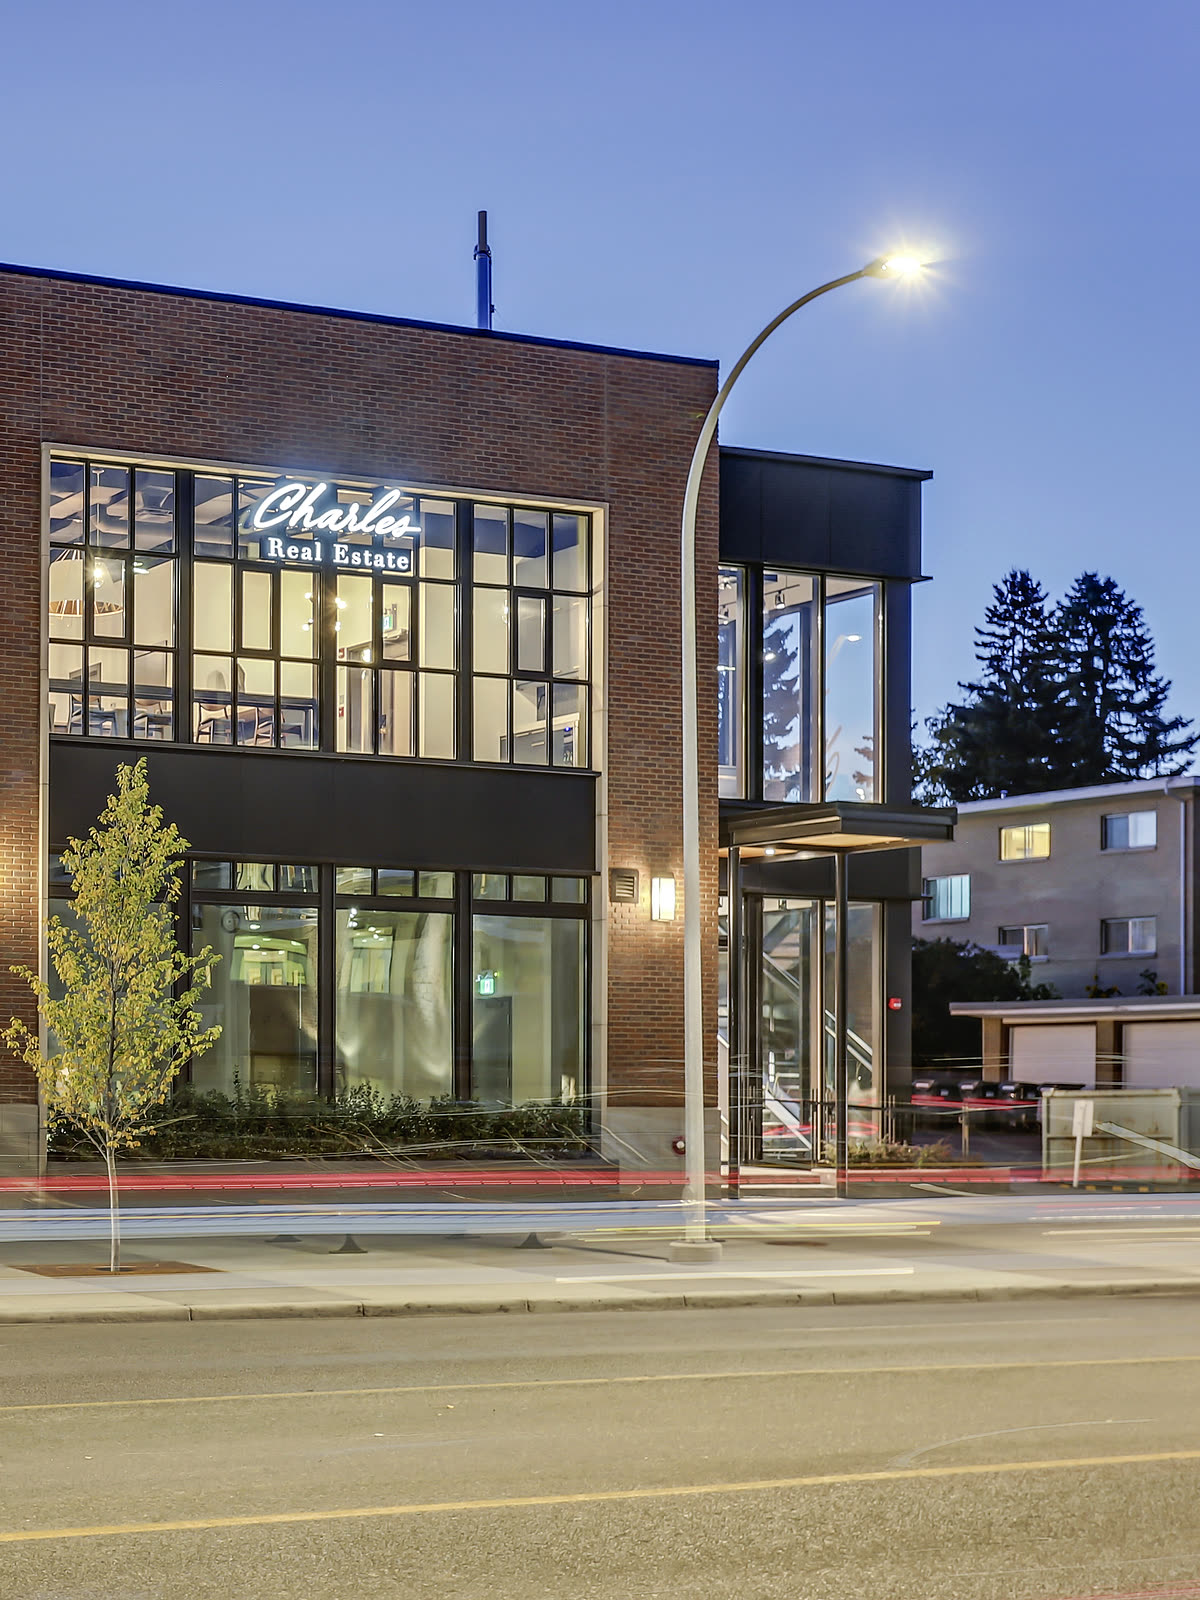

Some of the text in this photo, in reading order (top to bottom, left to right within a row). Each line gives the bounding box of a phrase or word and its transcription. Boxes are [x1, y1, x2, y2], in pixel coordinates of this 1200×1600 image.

[253, 482, 422, 538] Charles
[267, 537, 410, 570] Real Estate
